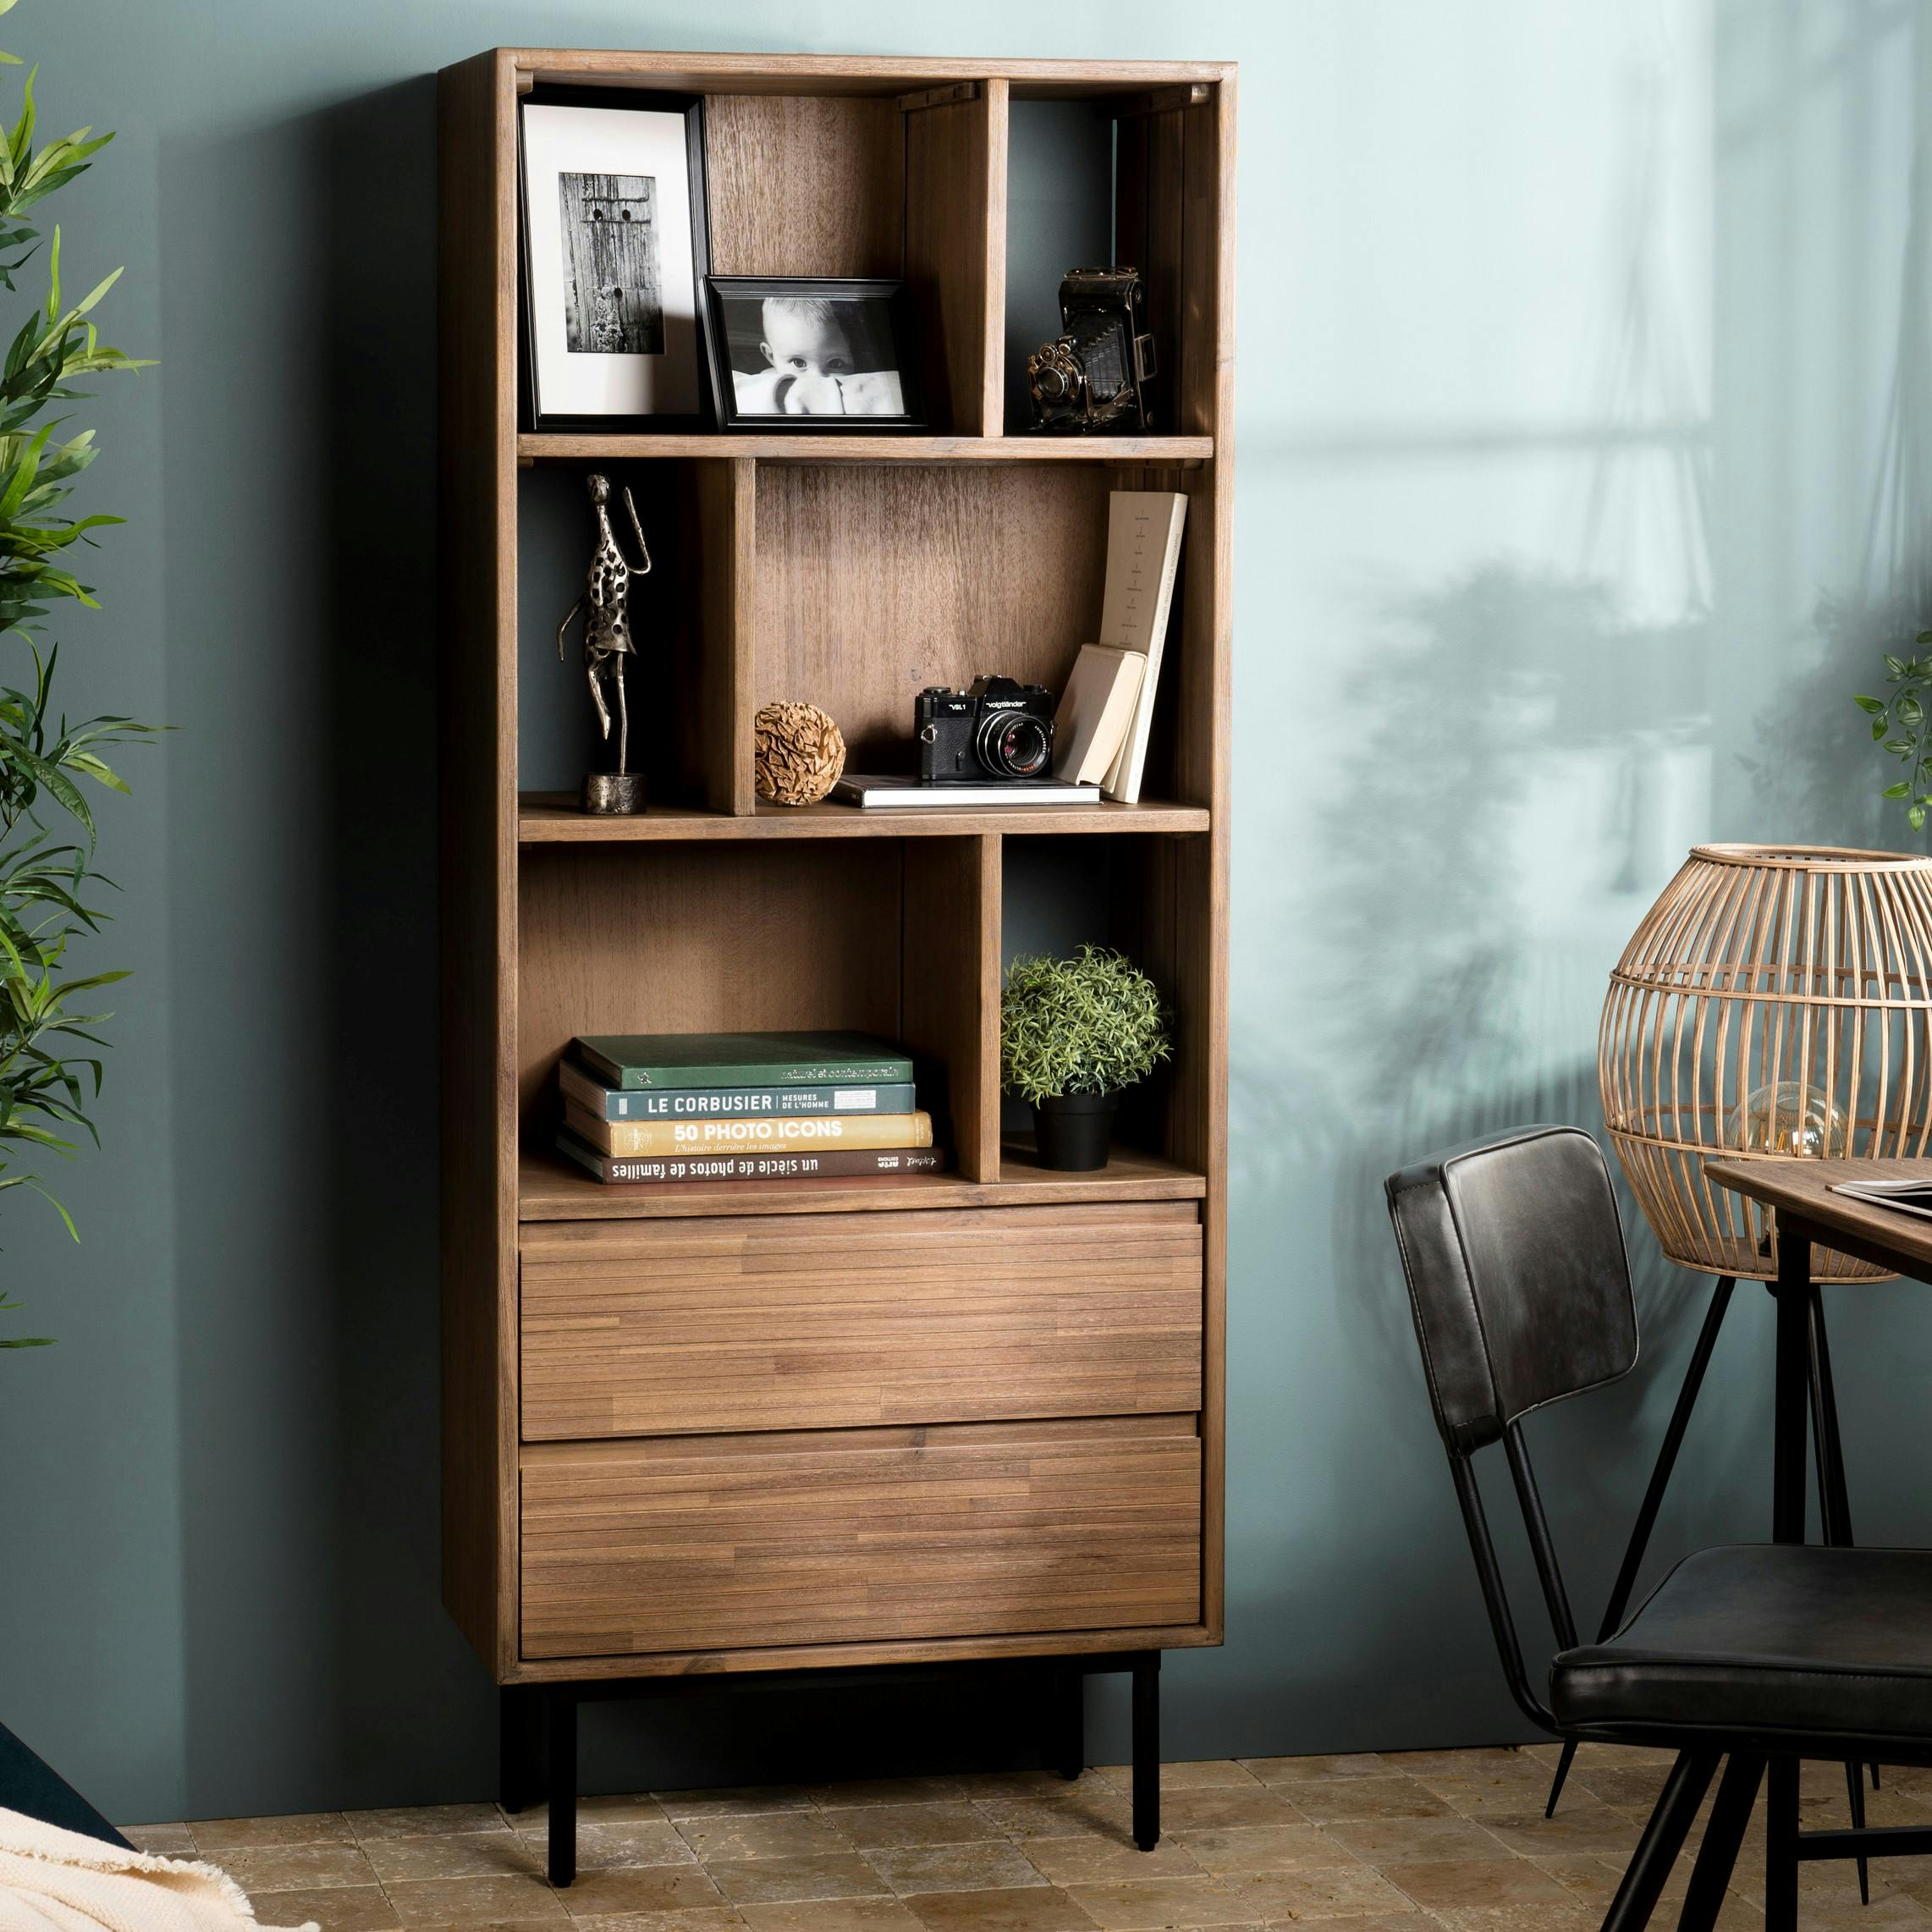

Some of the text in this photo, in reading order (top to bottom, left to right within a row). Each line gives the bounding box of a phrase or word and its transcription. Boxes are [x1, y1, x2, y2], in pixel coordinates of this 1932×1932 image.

[817, 1068, 828, 1079] et
[828, 1066, 899, 1079] contemporain
[648, 1095, 773, 1114] LE CORBUSIER
[782, 1093, 817, 1102] MESURES
[674, 1120, 843, 1142] 50 PHOTO ICONS
[674, 1142, 787, 1153] L'histoire derrière les images
[612, 1159, 819, 1179] un siècle de photos de familles
